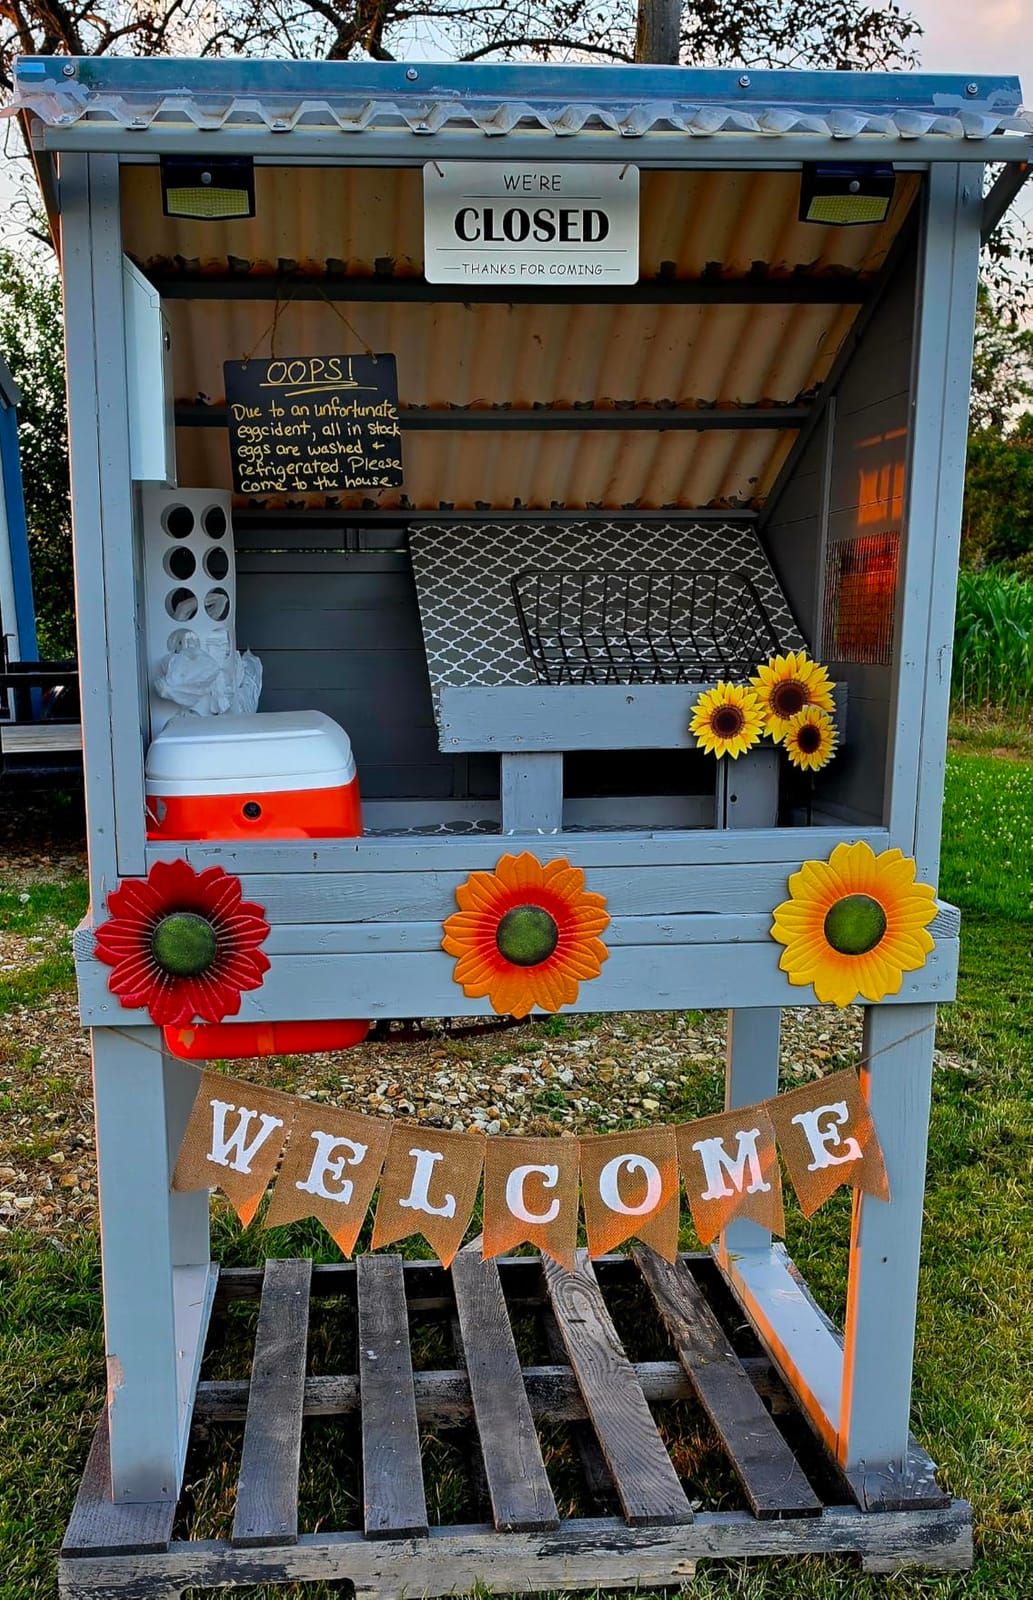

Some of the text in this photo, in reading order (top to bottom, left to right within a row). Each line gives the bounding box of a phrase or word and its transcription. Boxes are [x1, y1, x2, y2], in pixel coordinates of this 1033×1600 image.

[503, 174, 562, 191] WE'RE
[454, 207, 610, 242] CLOSED
[462, 263, 603, 275] THANKS FOR COMING
[267, 357, 354, 384] OOPS!
[231, 396, 399, 421] Due to an unfortunate
[237, 420, 401, 442] eggcident, all in stock
[237, 443, 271, 463] eggs
[275, 445, 301, 456] are
[307, 439, 363, 456] washed
[238, 455, 403, 482] refrigerated. Please
[241, 475, 399, 493] come to the house.
[206, 1099, 863, 1224] WELCOME
